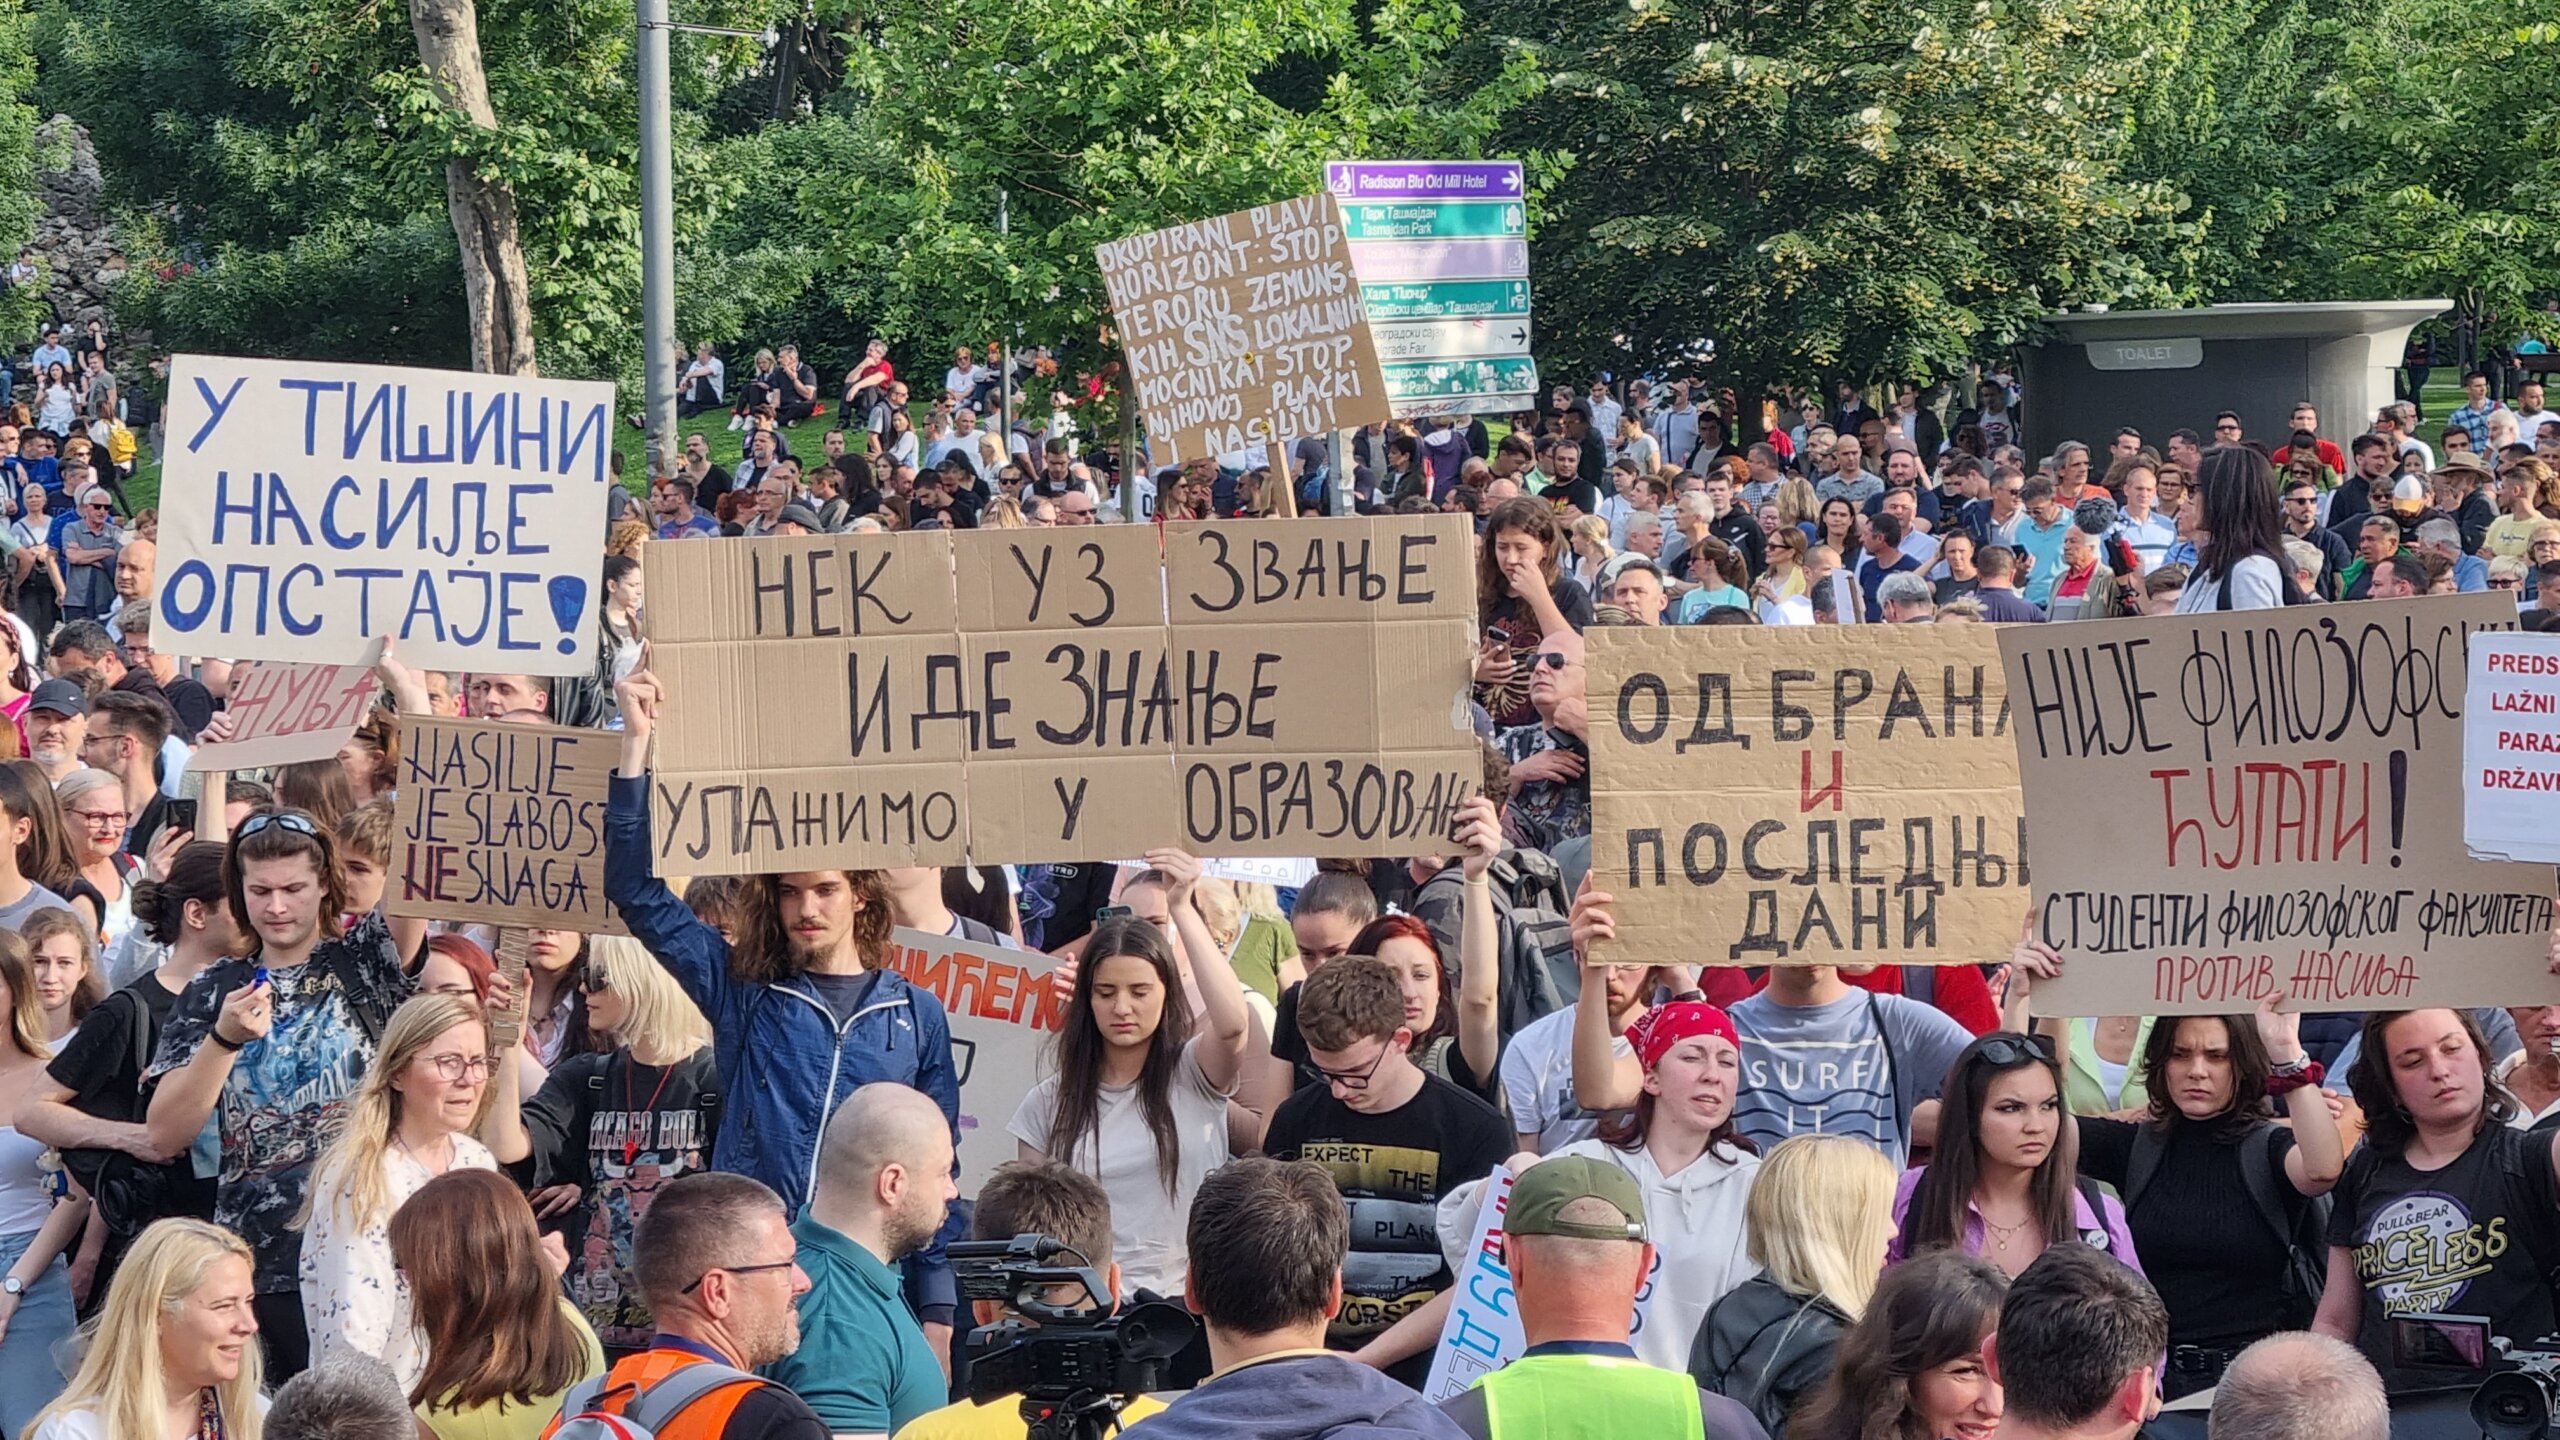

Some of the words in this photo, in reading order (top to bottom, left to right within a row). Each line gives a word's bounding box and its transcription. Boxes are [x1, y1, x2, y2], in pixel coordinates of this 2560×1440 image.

[1360, 174, 1405, 189] Radisson
[1407, 174, 1424, 189] Blu
[1426, 174, 1442, 188] Old
[1445, 174, 1460, 188] Mill
[1463, 174, 1487, 188] Hotel
[1252, 194, 1328, 238] PLAVI
[1361, 207, 1386, 220] Парк
[1388, 206, 1437, 221] Ташмајдан
[1412, 221, 1432, 234] Park
[1270, 225, 1340, 263] STOP
[1114, 285, 1231, 340] TERORU
[1365, 288, 1390, 300] Хала
[1129, 337, 1180, 379] KIH
[1183, 314, 1249, 366] SNS
[1254, 295, 1367, 349] LOKALNIH
[1374, 327, 1420, 341] еоградски
[1410, 342, 1426, 354] Fair
[2117, 347, 2172, 361] TOALET
[187, 376, 248, 453] У
[280, 378, 606, 482] ТИШИНИ
[212, 471, 554, 556] НАСИЉЕ
[161, 560, 587, 655] ОПСТАЈЕ!
[752, 547, 912, 637] НЕК
[1010, 543, 1116, 627] УЗ
[1190, 529, 1437, 612] ЗВАЊЕ
[848, 651, 1016, 757] ИДЕ
[1036, 643, 1281, 747] ЗНАЊЕ
[2022, 639, 2172, 758] НИЈЕ
[2181, 616, 2515, 762] ФИЛОЗОФС
[2492, 689, 2555, 714] LAŽNI
[405, 726, 578, 796] NASILJE
[1801, 750, 1843, 813] И
[406, 788, 452, 843] JE
[658, 782, 957, 860] УЛАЖИМО
[1054, 776, 1088, 841] У
[402, 844, 459, 901] NE
[1729, 887, 1937, 960] ДАНИ
[2042, 891, 2208, 954] СТУДЕНТИ
[2218, 884, 2414, 952] ФИЛОЗОФСКОГ
[2418, 889, 2557, 952] ФАКУЛТЕТА
[2154, 952, 2279, 1003] ПРОТИВ
[1749, 1060, 1869, 1090] SURF
[1787, 1105, 1829, 1133] IT
[1303, 1147, 1373, 1164] EXPECT
[1389, 1169, 1431, 1192] THE
[2377, 1204, 2450, 1234] PULL&BEAR
[2352, 1217, 2508, 1277] PRICELESS
[2384, 1288, 2453, 1320] PARTY
